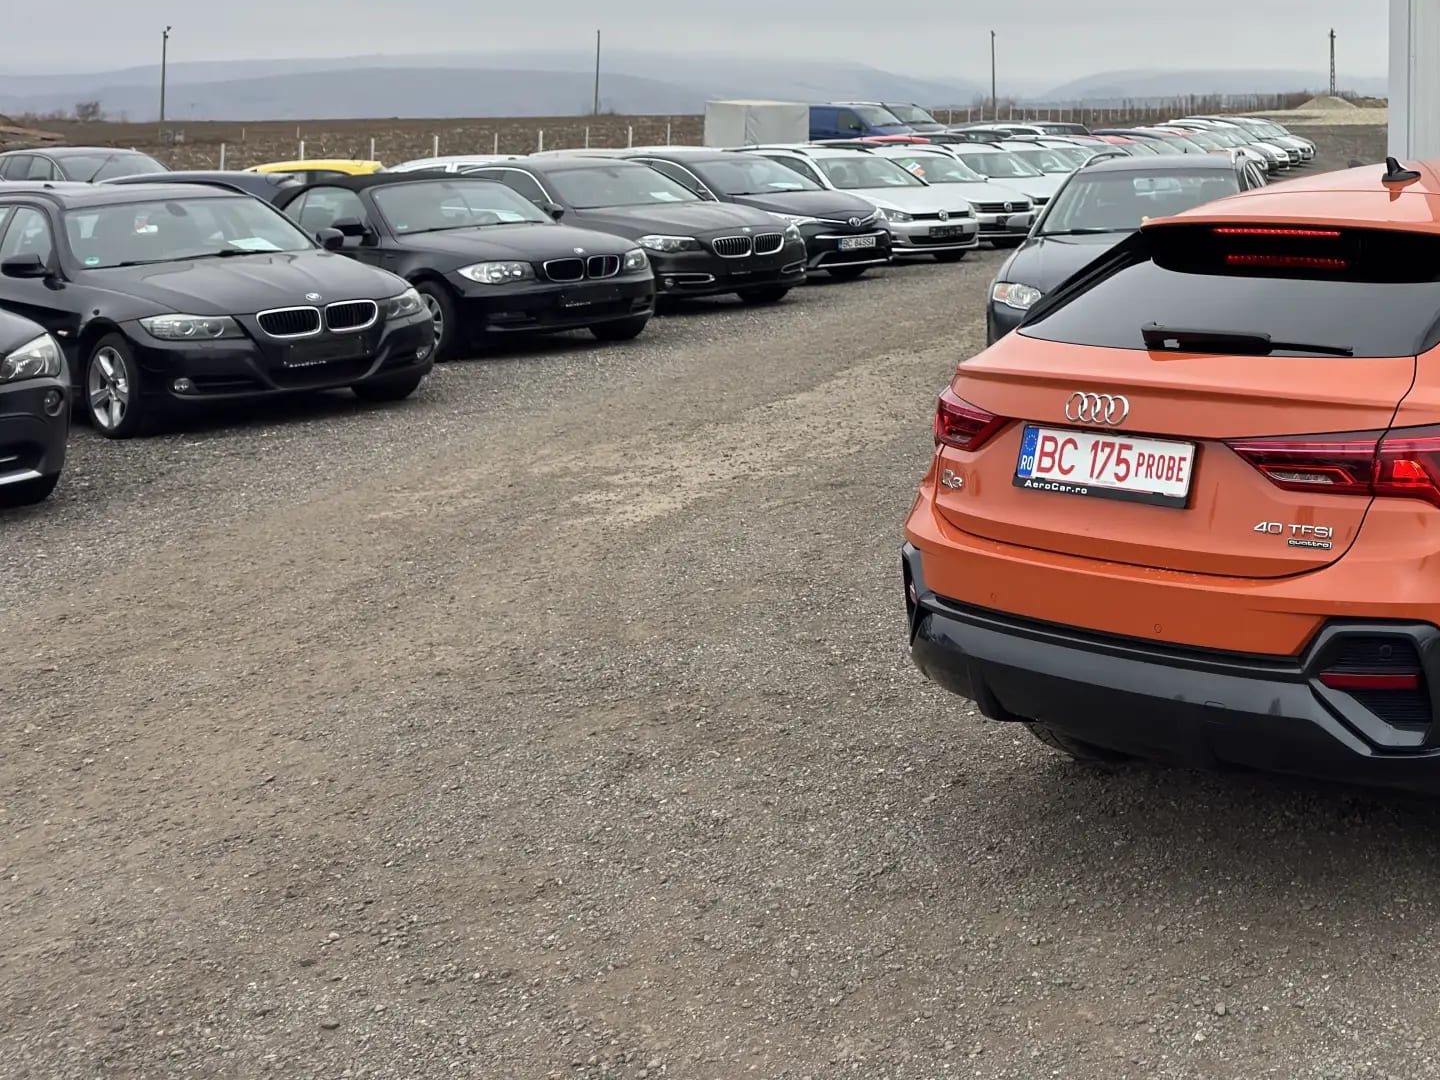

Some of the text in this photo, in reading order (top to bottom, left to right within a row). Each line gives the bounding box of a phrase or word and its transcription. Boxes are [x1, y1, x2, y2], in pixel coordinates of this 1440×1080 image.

[1020, 455, 1034, 471] RO
[1036, 435, 1187, 483] BC 175 PROBE
[1023, 479, 1088, 494] AeroCar.ro
[1253, 521, 1333, 539] 40 TFSI
[1288, 539, 1330, 548] quattro
